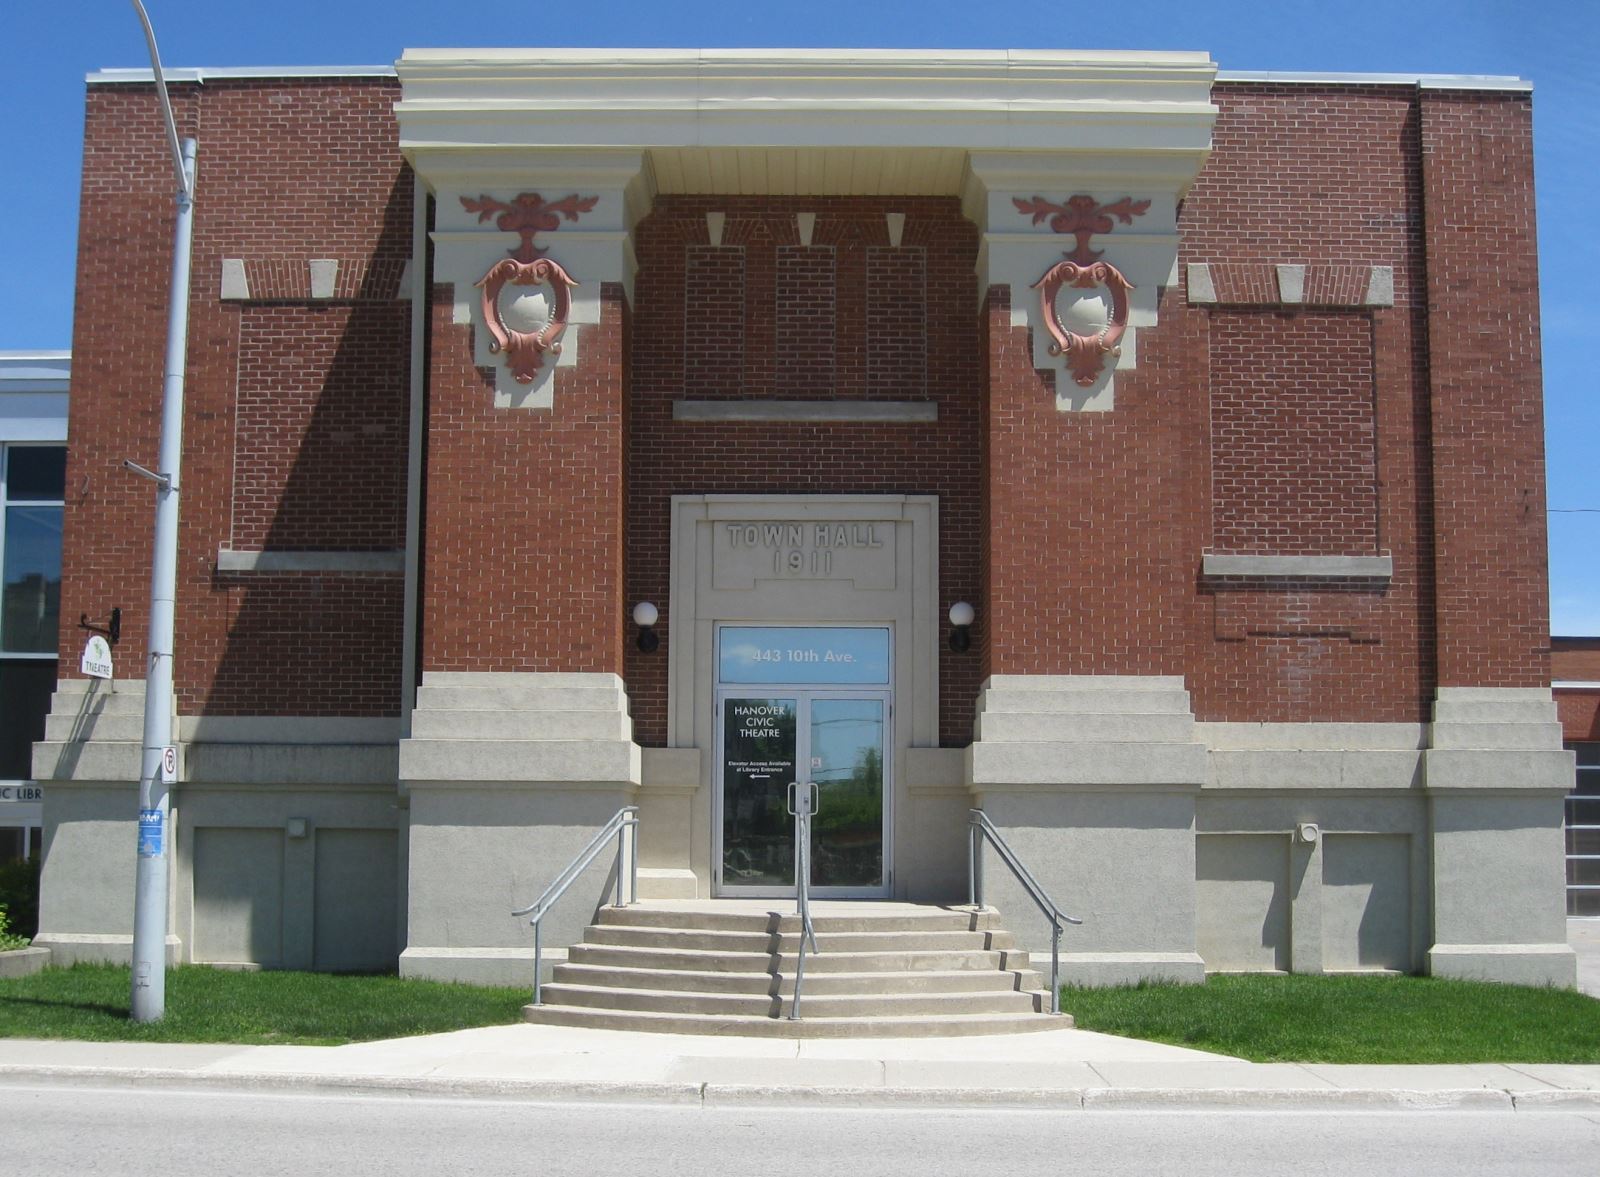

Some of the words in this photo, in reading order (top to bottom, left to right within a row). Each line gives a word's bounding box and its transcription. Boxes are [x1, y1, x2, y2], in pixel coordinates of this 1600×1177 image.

[727, 524, 804, 548] TOWN
[814, 524, 884, 548] HALL
[774, 550, 832, 574] 1911
[752, 649, 781, 662] 443
[786, 649, 819, 662] 10th
[824, 649, 857, 663] Ave.
[734, 706, 785, 716] HANOVER
[745, 717, 775, 727] CIVIC
[740, 728, 780, 738] THEATRE
